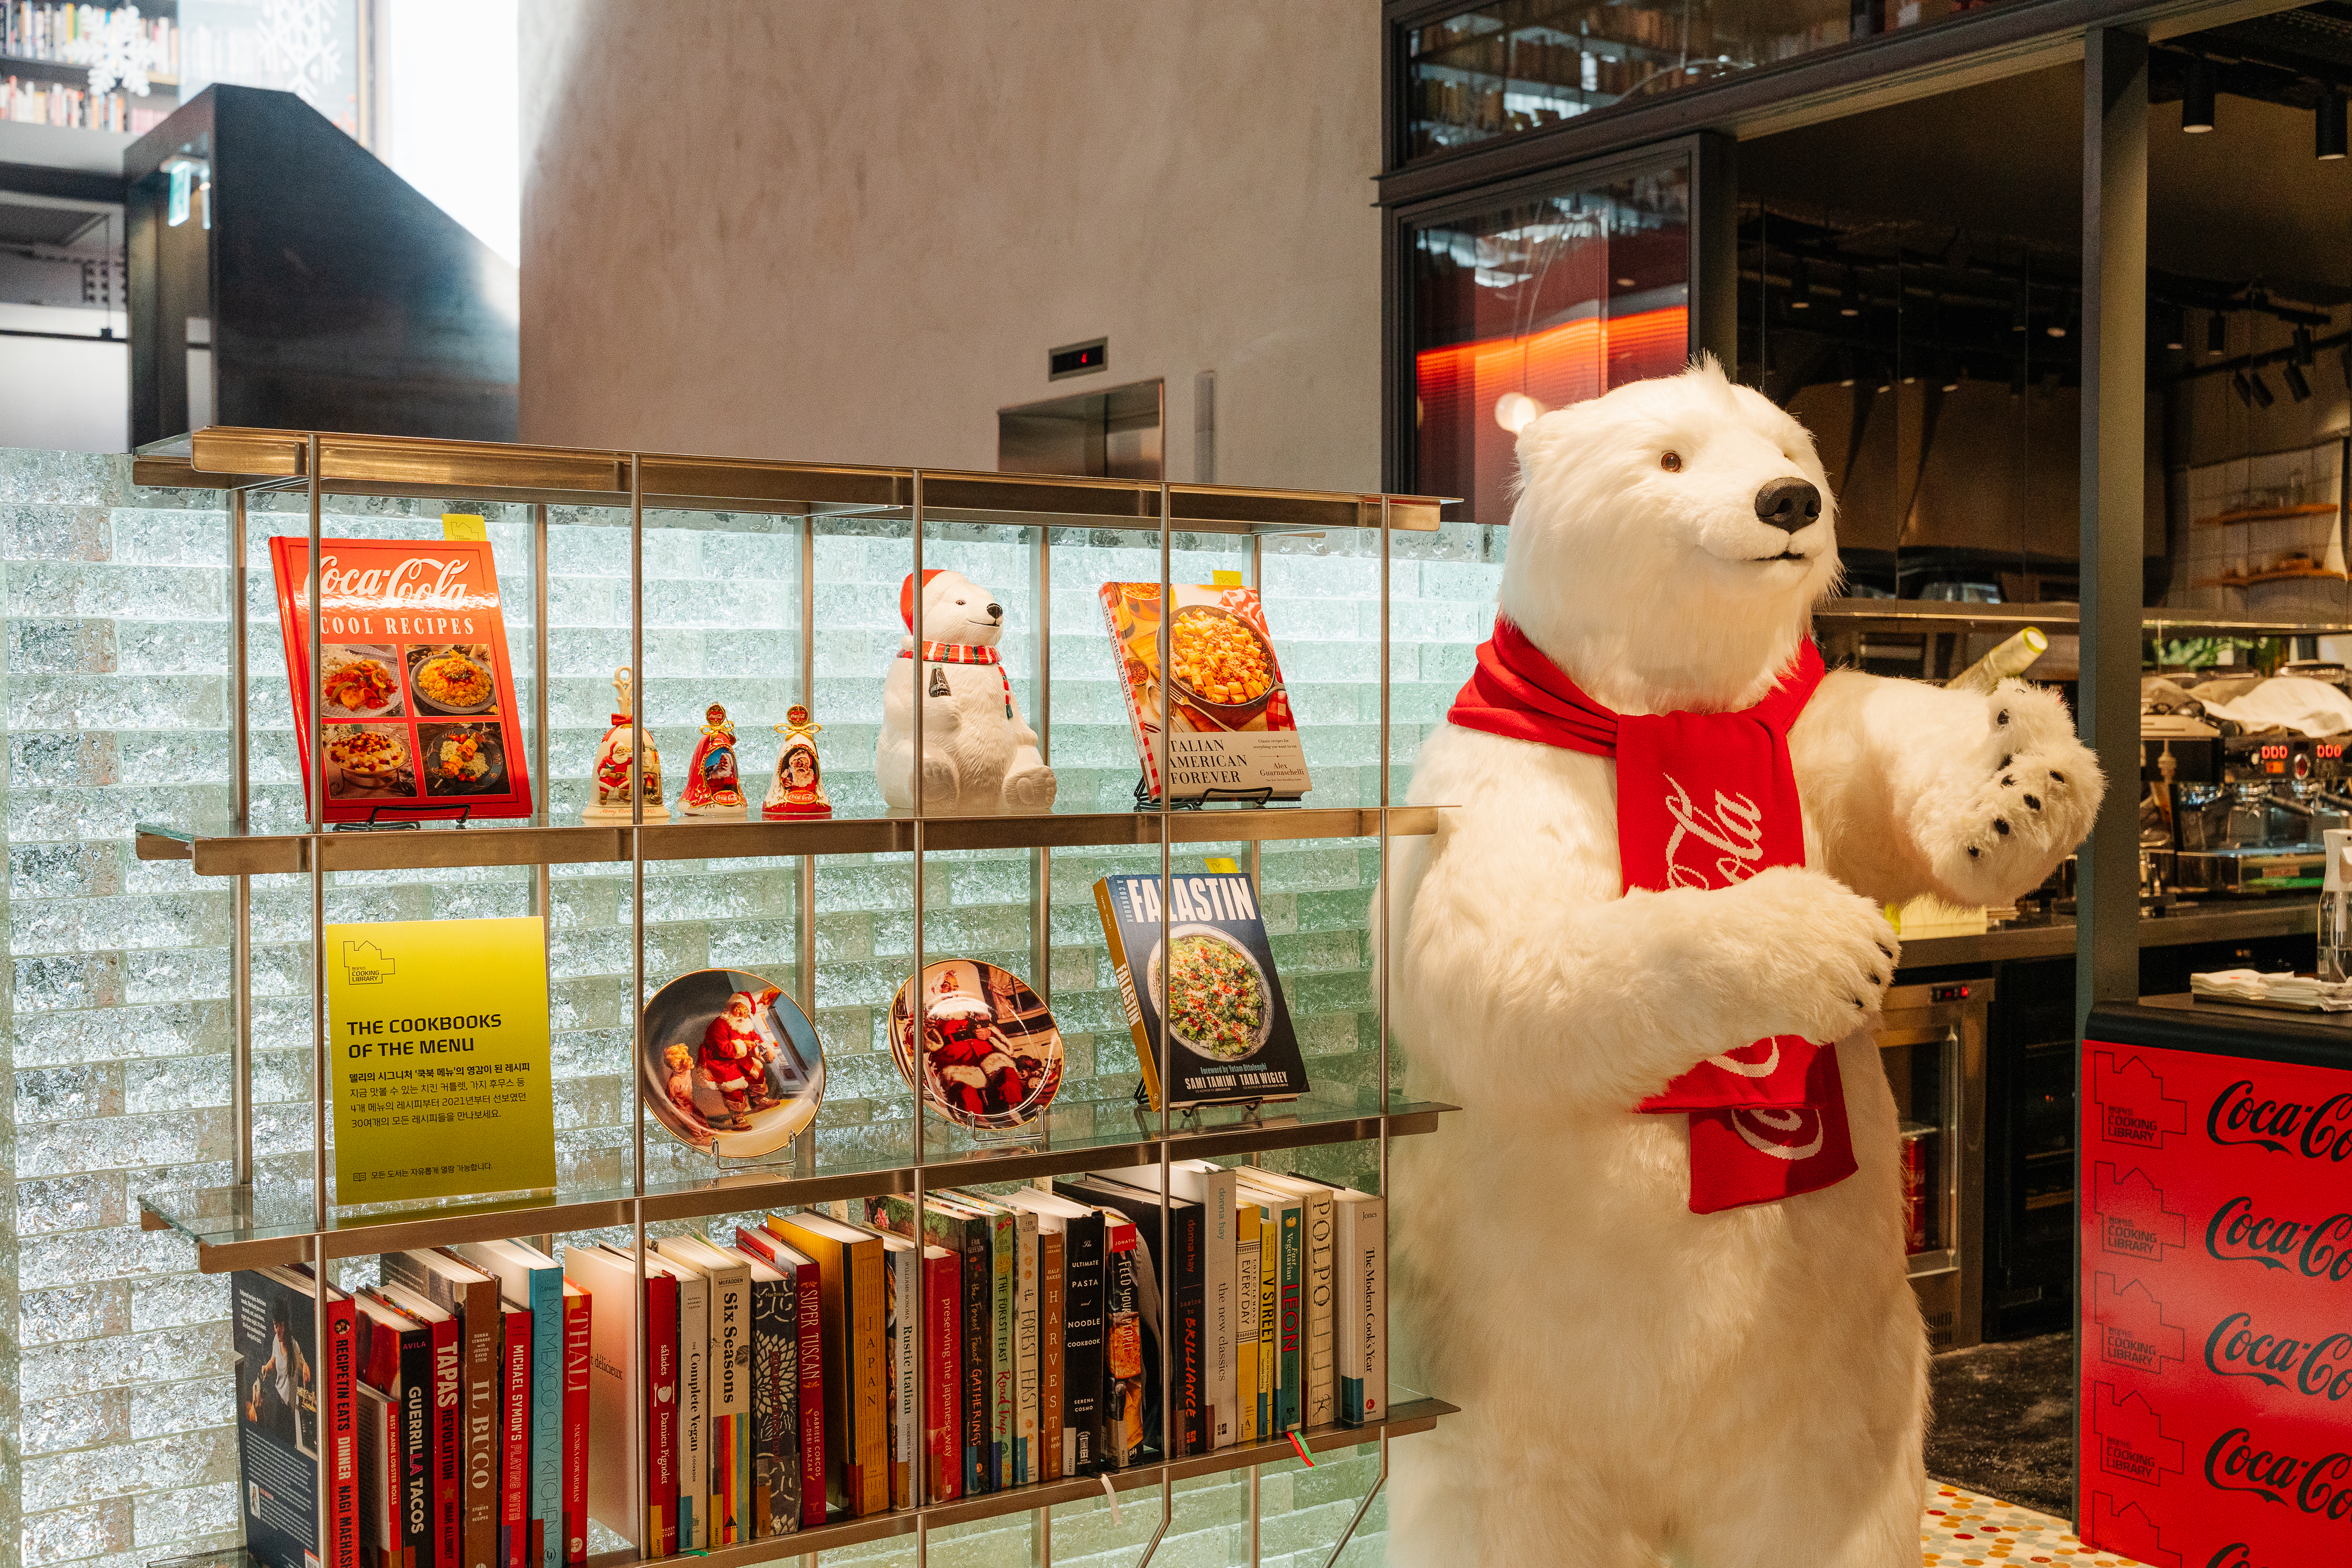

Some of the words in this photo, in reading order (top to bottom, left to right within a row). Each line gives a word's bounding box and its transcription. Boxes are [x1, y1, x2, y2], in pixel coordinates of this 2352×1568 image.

[303, 555, 470, 606] Coca-Cola
[322, 617, 373, 635] COOL
[386, 617, 475, 635] RECIPES
[1104, 606, 1114, 633] ITALIAN
[1112, 636, 1122, 670] AMERICAN
[1121, 671, 1131, 702] FOREVER
[1170, 739, 1225, 752] TALIAN
[1170, 771, 1241, 784] FOREVER
[1116, 963, 1141, 1027] FALASTIN
[347, 1020, 384, 1035] THE
[389, 1014, 502, 1034] COOKBOOKS
[348, 1044, 373, 1058] OF
[377, 1041, 415, 1057] THE
[420, 1038, 474, 1054] MENU
[349, 1072, 376, 1083] 델리의
[378, 1070, 413, 1081] 시그니처
[467, 1064, 492, 1075] 영감이
[494, 1064, 503, 1074] 된
[505, 1062, 530, 1072] 레시피
[1184, 1076, 1207, 1089] SAMI
[1206, 1075, 1237, 1088] TAMIMI
[1239, 1073, 1260, 1086] TARA
[1259, 1071, 1288, 1084] WIGLEY
[1200, 1065, 1222, 1075] Foreword
[1222, 1065, 1229, 1074] by
[1243, 1063, 1267, 1072] Ottolenghi
[350, 1087, 368, 1098] 지금
[370, 1086, 387, 1097] 맛볼
[389, 1086, 399, 1096] 수
[402, 1085, 419, 1095] 있는
[421, 1083, 438, 1094] 치킨
[440, 1081, 468, 1092] 커틀렛,
[470, 1080, 487, 1090] 가지
[489, 1078, 514, 1088] 후무스
[516, 1078, 525, 1088] 등
[350, 1103, 366, 1113] 4개
[368, 1101, 394, 1113] 메뉴의
[396, 1098, 440, 1110] 레시피부터
[442, 1095, 490, 1107] 2021년부터
[493, 1092, 527, 1104] 선보였던
[352, 1116, 389, 1128] 30여개의
[392, 1115, 410, 1126] 모든
[412, 1112, 455, 1124] 레시피들을
[457, 1109, 502, 1121] 만나보세요.
[2108, 1115, 2157, 1132] COOKING
[2108, 1126, 2154, 1142] LIBRARY
[2207, 1080, 2352, 1162] Coca-Co
[1218, 1188, 1226, 1223] donna
[1362, 1212, 1377, 1221] Jones
[1217, 1223, 1226, 1241] hay
[2108, 1226, 2157, 1243] COOKING
[2108, 1236, 2154, 1254] LIBRARY
[2205, 1196, 2352, 1282] Coca-Co
[1285, 1232, 1294, 1281] Vegetarian
[1312, 1199, 1331, 1307] POLPO
[1365, 1247, 1375, 1268] The
[718, 1278, 743, 1286] McFADDEN
[998, 1274, 1008, 1294] THE
[1072, 1279, 1098, 1288] PASTA
[1118, 1261, 1132, 1286] FEED
[1241, 1259, 1251, 1296] EVERY
[1262, 1276, 1274, 1286] V
[1366, 1270, 1376, 1312] Modern
[724, 1292, 739, 1323] Six
[800, 1290, 818, 1328] SUPER
[1023, 1289, 1034, 1302] the
[1120, 1288, 1131, 1314] YOUR
[1218, 1282, 1228, 1303] the
[542, 1299, 558, 1328] MY
[942, 1298, 953, 1358] preserving
[998, 1298, 1008, 1332] FOREST
[1068, 1318, 1100, 1329] NOODLE
[1241, 1300, 1250, 1325] DAY
[1262, 1291, 1274, 1345] STREET
[1282, 1283, 1298, 1352] LEON
[1365, 1313, 1376, 1347] Cook's
[403, 1341, 426, 1350] AVILA
[568, 1311, 589, 1393] THALI
[903, 1325, 913, 1367] Rustic
[998, 1336, 1008, 1363] FEAST
[1021, 1309, 1035, 1360] FOREST
[1067, 1339, 1100, 1348] COOKBOOK
[1121, 1318, 1133, 1353] PEOPLE
[336, 1339, 349, 1399] RECIPETIN
[512, 1345, 524, 1391] MICHAEL
[541, 1333, 558, 1407] MEXICO
[594, 1353, 623, 1381] délicieux
[723, 1326, 738, 1403] Seasons
[801, 1332, 820, 1379] TUSCAN
[866, 1316, 876, 1407] JAPAN
[944, 1361, 953, 1379] the
[1049, 1290, 1058, 1429] HARVEST
[1184, 1318, 1197, 1418] BRILLIANCE
[1218, 1335, 1228, 1382] classics
[1365, 1349, 1376, 1373] Year
[2204, 1312, 2352, 1401] Coca-Co
[437, 1341, 457, 1407] TAPAS
[688, 1353, 701, 1412] Complete
[995, 1368, 1011, 1409] Road
[1021, 1369, 1036, 1410] FEAST
[472, 1379, 490, 1409] IL
[904, 1369, 913, 1415] Italian
[942, 1383, 953, 1431] japanese
[970, 1369, 982, 1446] GATHERINGS
[337, 1402, 350, 1431] EATS
[409, 1386, 423, 1476] GUERRILLA
[511, 1394, 523, 1440] SYMON'S
[541, 1412, 558, 1454] CITY
[661, 1412, 670, 1447] Damien
[688, 1414, 701, 1452] Vegan
[995, 1407, 1011, 1436] Trip
[338, 1436, 351, 1480] DINNER
[442, 1409, 455, 1480] REVOLUTION
[472, 1414, 489, 1489] BUCO
[943, 1434, 952, 1457] way
[510, 1444, 522, 1489] PLAYING
[657, 1449, 670, 1485] Pignolet
[2204, 1428, 2352, 1520] Coca-Co
[339, 1485, 351, 1513] NAGI
[410, 1477, 424, 1534] TACOS
[509, 1491, 520, 1521] WITH
[541, 1459, 558, 1535] KITCHEN
